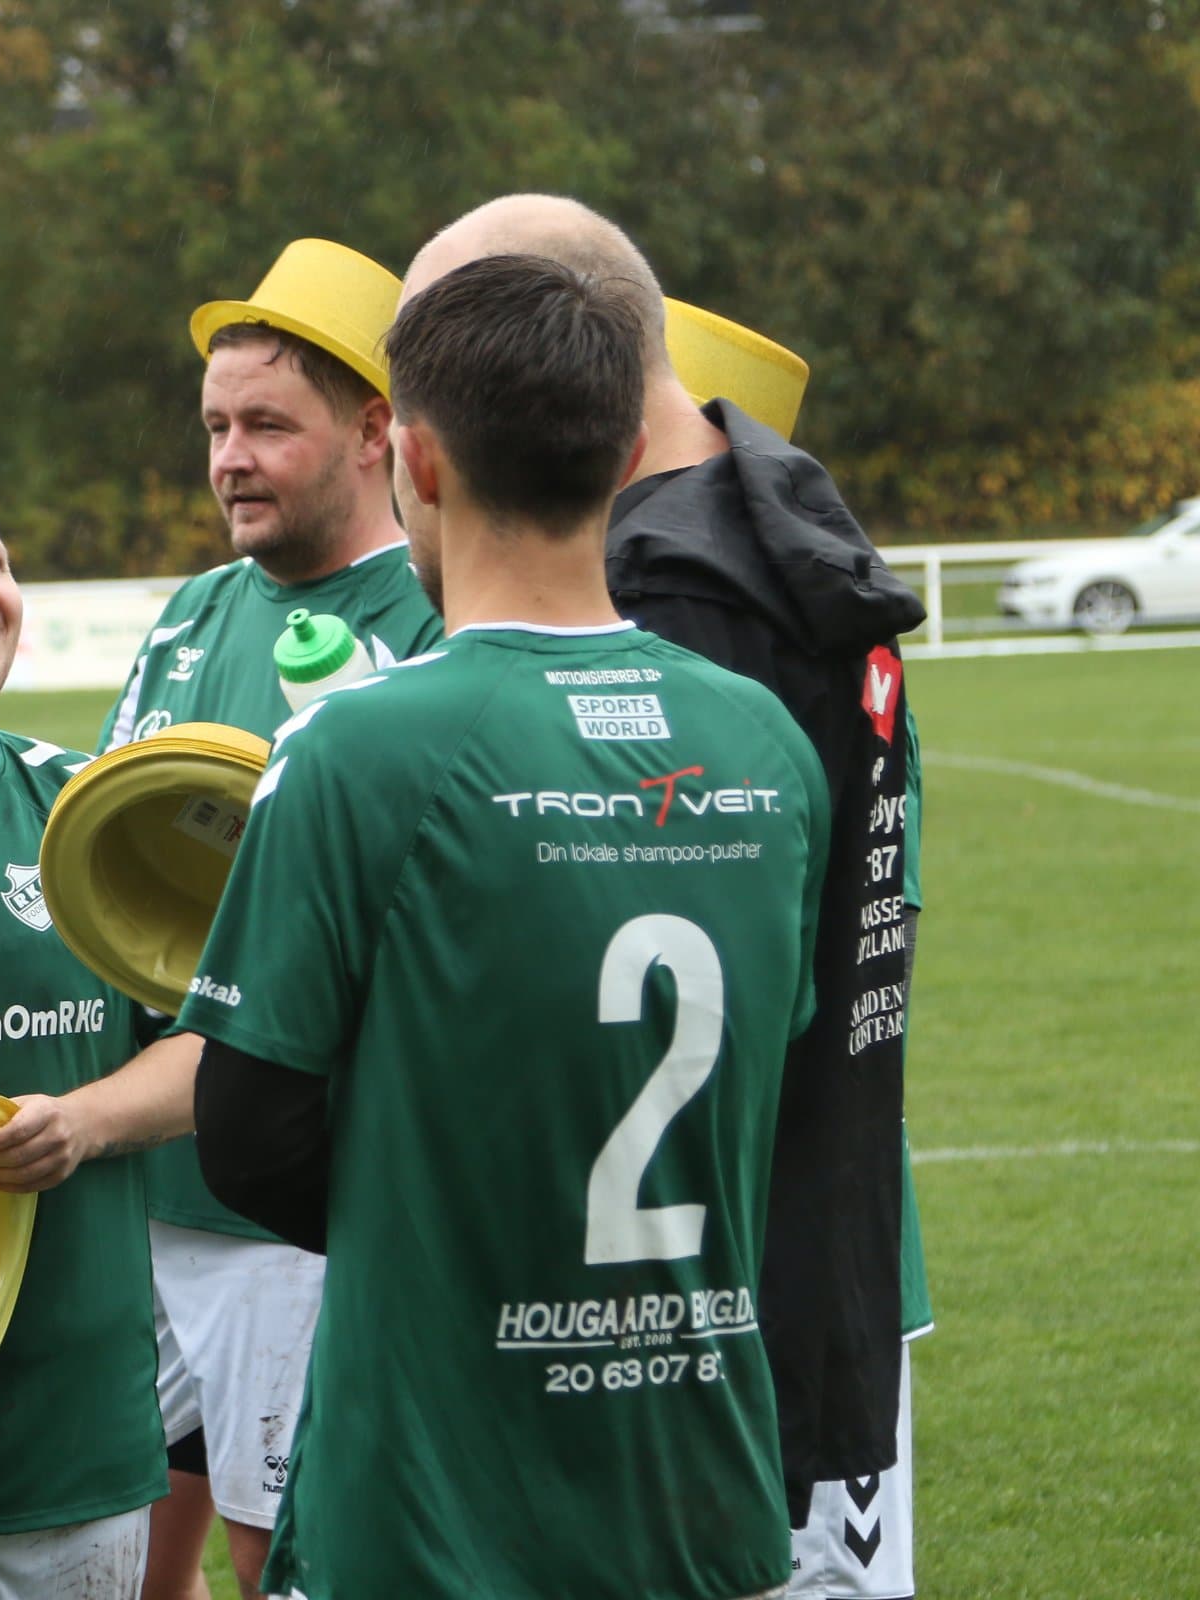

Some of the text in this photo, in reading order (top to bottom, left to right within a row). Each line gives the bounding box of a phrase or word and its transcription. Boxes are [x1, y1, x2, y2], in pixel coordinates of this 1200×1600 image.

[544, 669, 643, 685] MOTIONSHERRER
[577, 698, 655, 714] SPORTS
[584, 721, 661, 737] WORLD
[537, 840, 763, 864] Din lokale shampoo-pusher
[584, 913, 724, 1265] 2
[497, 1287, 754, 1339] HOUGAARD BYG.D
[546, 1363, 595, 1393] 20
[602, 1359, 643, 1390] 63
[649, 1354, 690, 1385] 07
